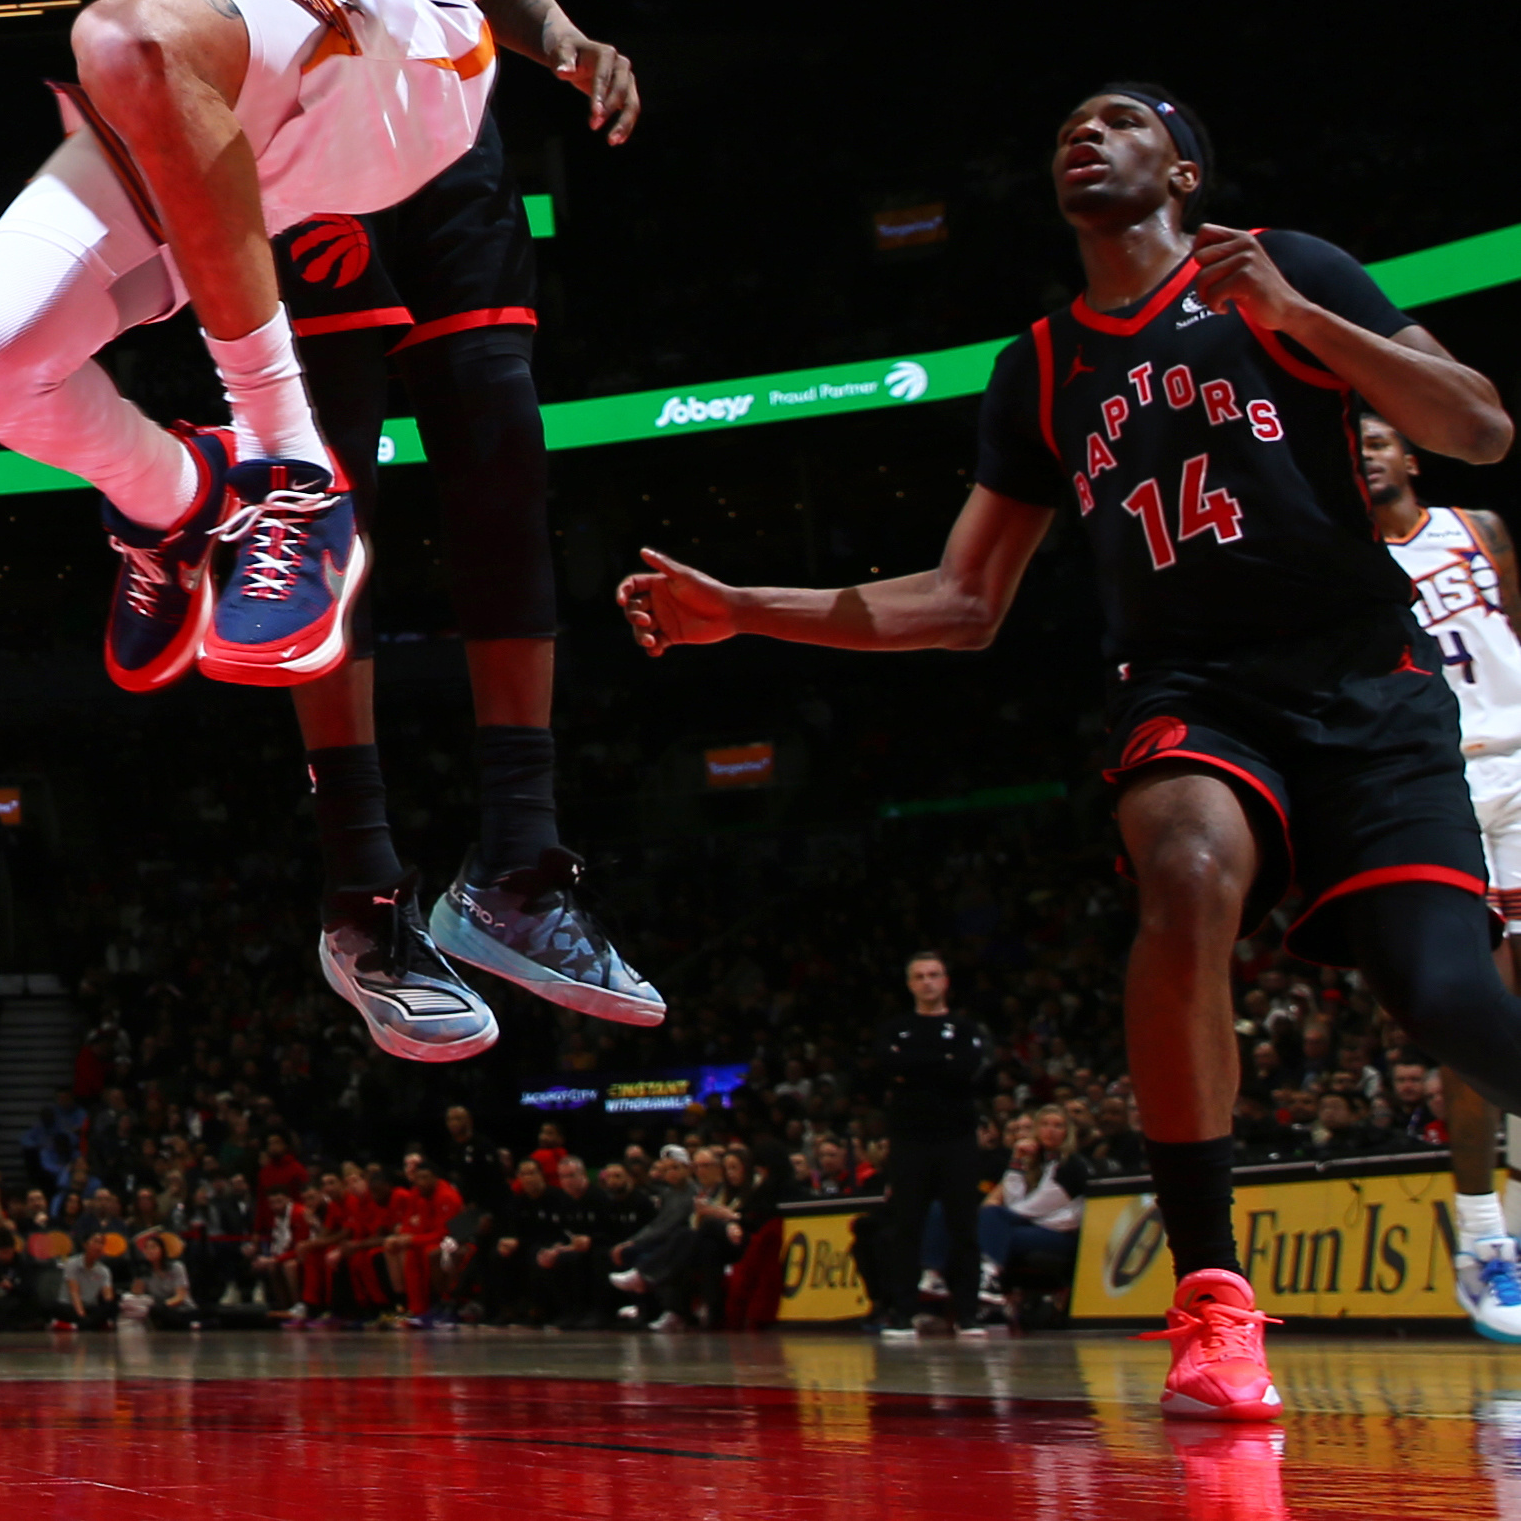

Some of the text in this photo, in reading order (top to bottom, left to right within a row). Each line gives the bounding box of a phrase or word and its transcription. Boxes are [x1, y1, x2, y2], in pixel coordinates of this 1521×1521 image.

[655, 381, 878, 427] Sobeys Proud Partner
[1071, 361, 1283, 516] RAPTORS
[1122, 453, 1243, 570] 14
[1443, 630, 1476, 684] 4
[1243, 1209, 1345, 1296] Fun
[1356, 1202, 1407, 1294] Is
